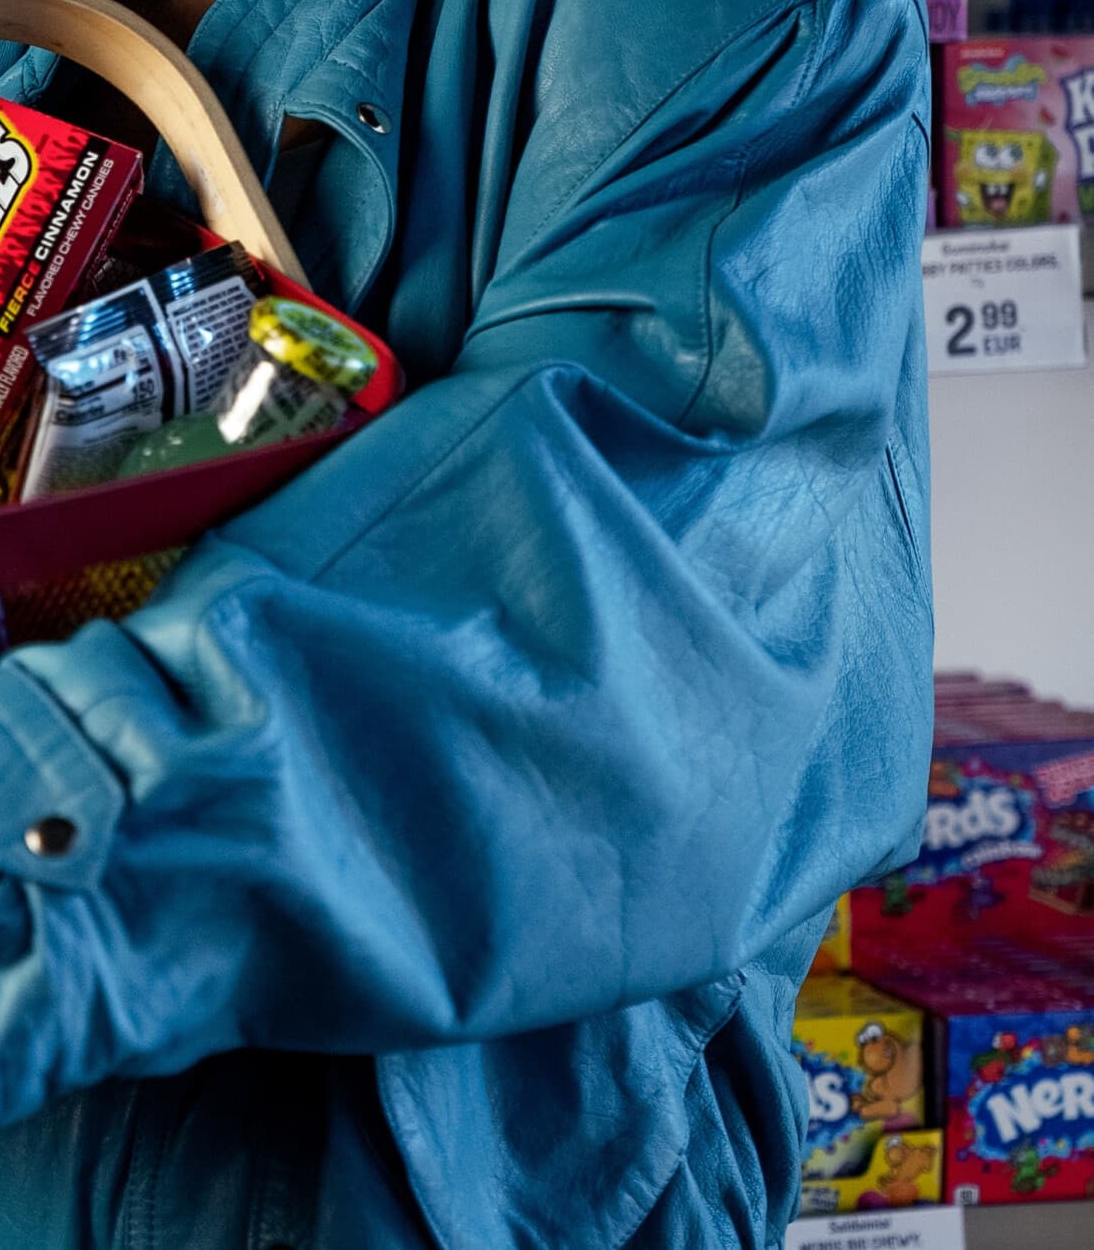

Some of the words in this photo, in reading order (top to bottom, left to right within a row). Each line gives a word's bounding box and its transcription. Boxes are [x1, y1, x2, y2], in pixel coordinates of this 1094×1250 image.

[26, 252, 64, 318] FLAVORED
[58, 210, 87, 256] CHEWY
[81, 156, 115, 212] CANDIES
[34, 150, 100, 262] CINNAMON
[945, 303, 977, 357] 2
[981, 300, 1018, 330] 99
[983, 334, 1022, 355] EUR
